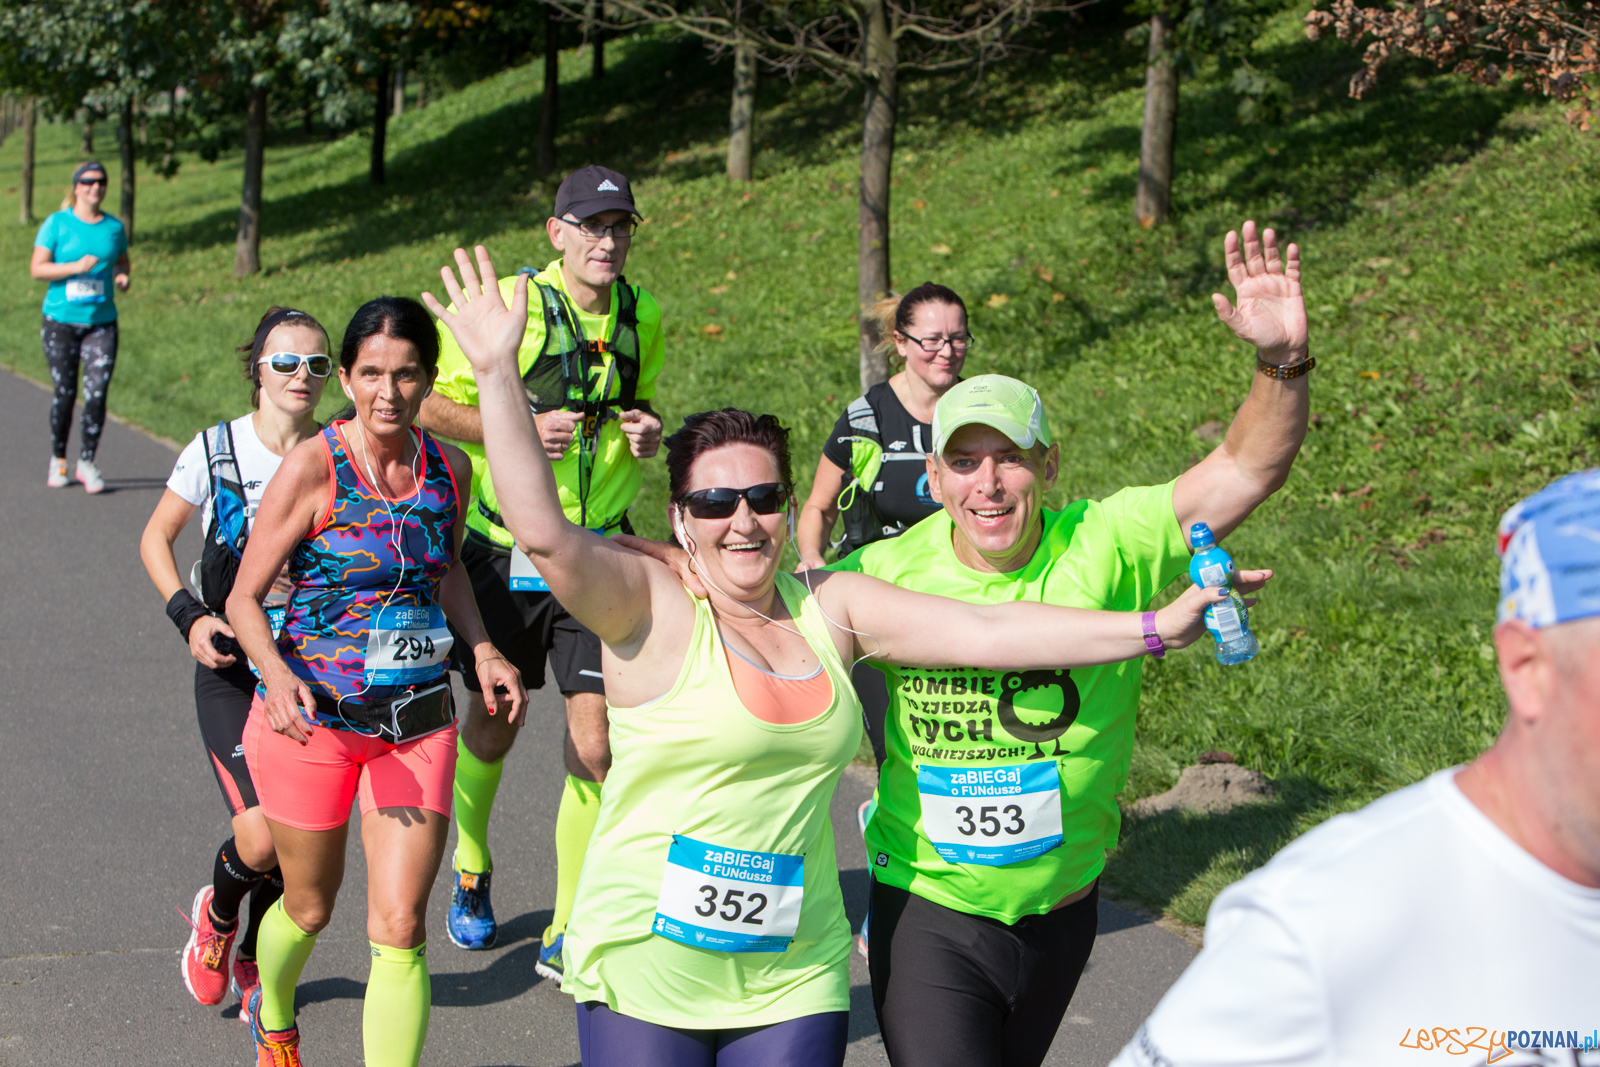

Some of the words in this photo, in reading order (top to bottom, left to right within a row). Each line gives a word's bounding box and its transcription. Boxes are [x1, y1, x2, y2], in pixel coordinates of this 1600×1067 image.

[395, 609, 430, 621] zaBIEGaj
[393, 635, 435, 661] 294
[900, 675, 995, 696] ZOMBIE
[921, 700, 992, 716] ZJEDZĄ
[909, 713, 995, 745] TYCH
[911, 745, 1026, 761] WOLNIEJSZYCH!
[950, 768, 1021, 785] zaBIEGaj
[951, 788, 959, 796] o
[961, 785, 1022, 796] FUNdusze
[955, 804, 1026, 837] 353
[704, 850, 775, 873] zaBIEGaj
[702, 864, 711, 873] o
[713, 864, 773, 883] FUNdusze
[694, 885, 768, 925] 352
